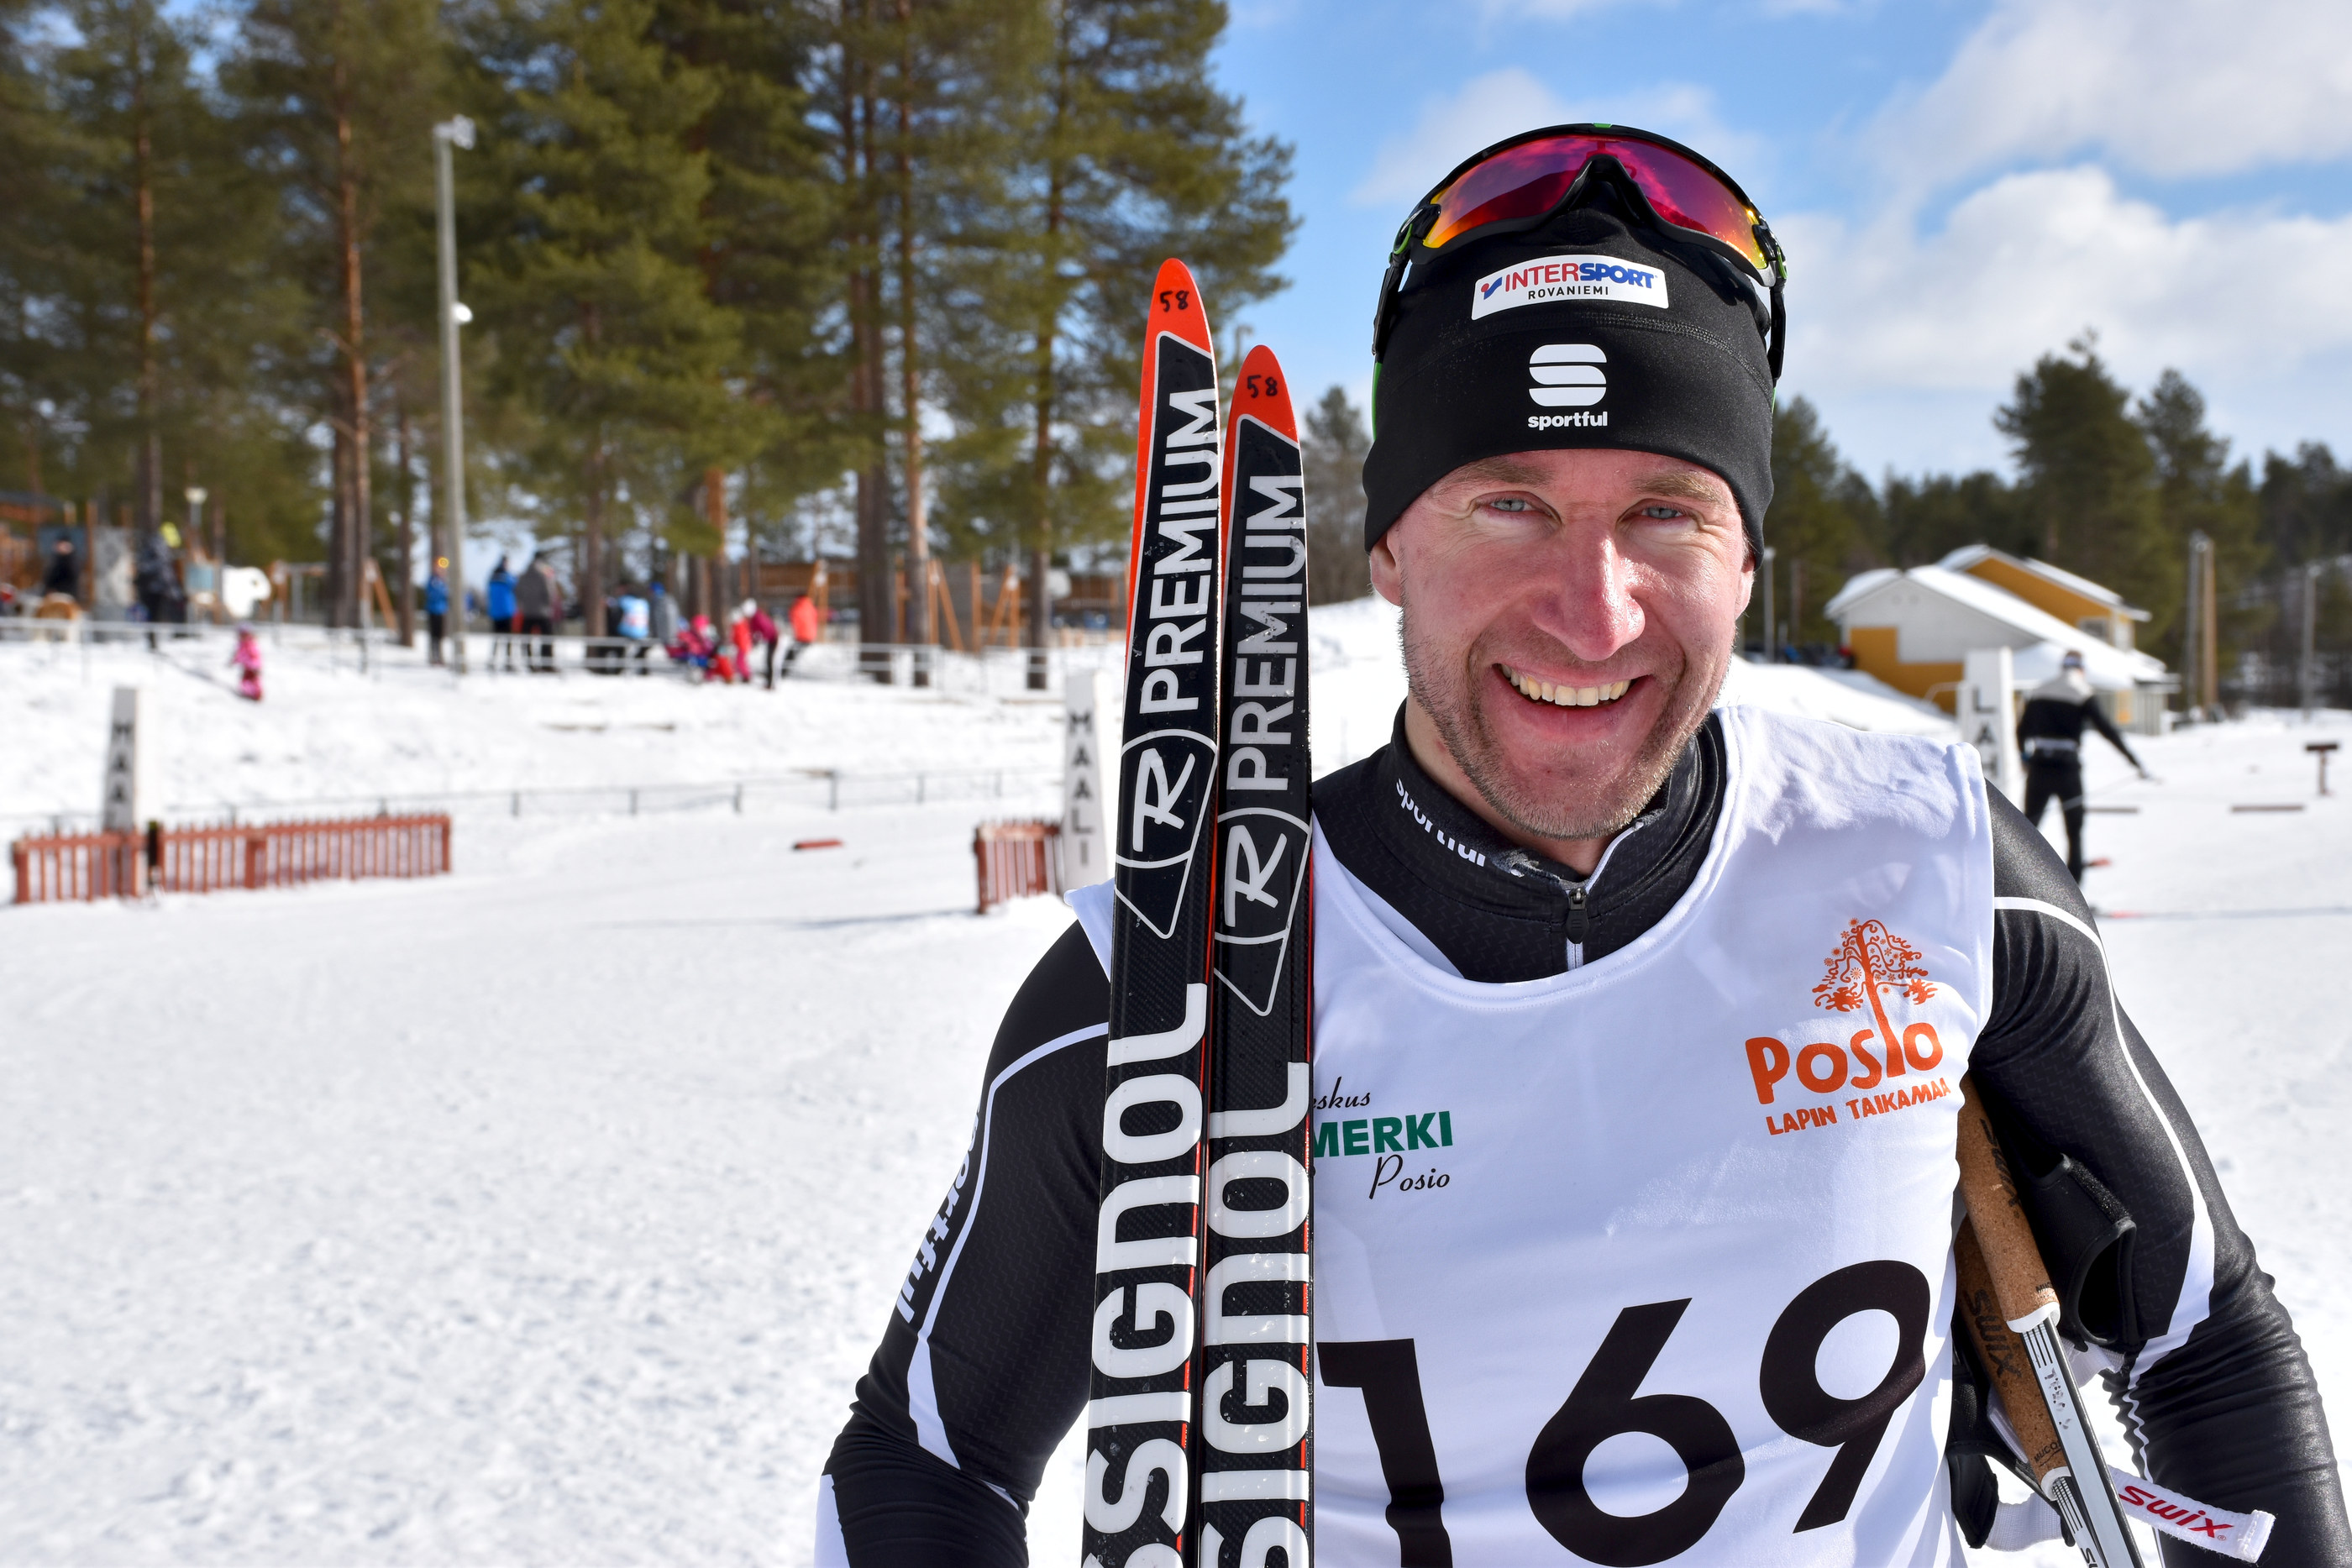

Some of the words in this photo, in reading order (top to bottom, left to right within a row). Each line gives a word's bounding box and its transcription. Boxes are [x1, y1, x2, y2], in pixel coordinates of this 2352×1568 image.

[1505, 262, 1656, 292] INTERSPORT
[1527, 286, 1609, 301] ROVANIEMI
[1160, 290, 1190, 312] 58
[1247, 375, 1278, 399] 58
[1527, 411, 1609, 431] sportful
[1139, 388, 1219, 715] PREMIUM
[1226, 475, 1306, 791] PREMIUM
[1766, 1104, 1838, 1136] LAPIN
[1845, 1077, 1952, 1120] TAIKAMAA
[1368, 1154, 1451, 1200] Posio
[1315, 1259, 1931, 1568] 169
